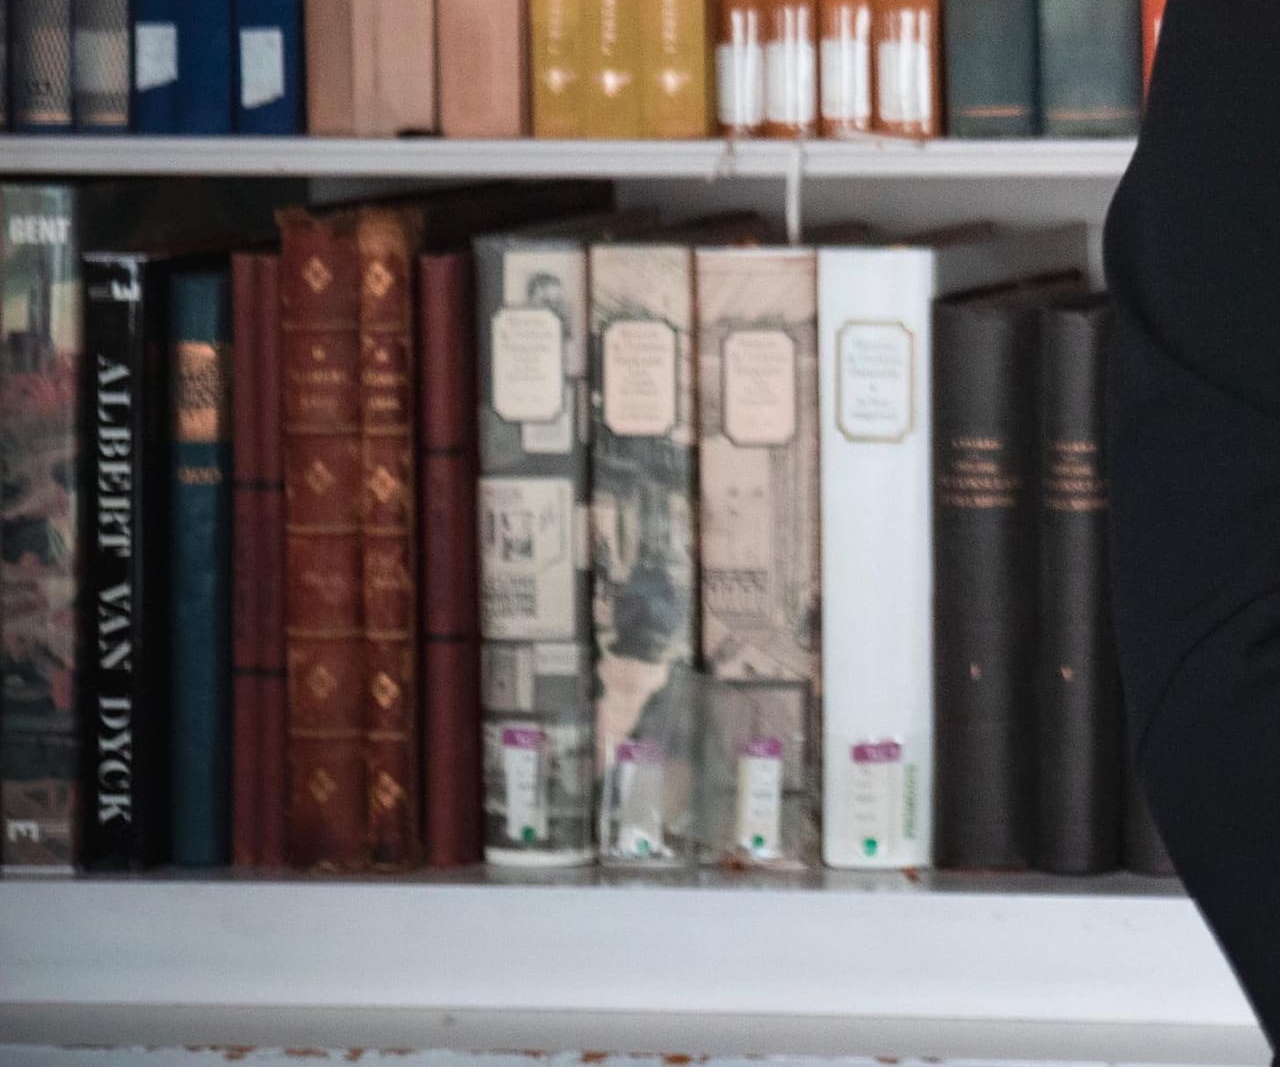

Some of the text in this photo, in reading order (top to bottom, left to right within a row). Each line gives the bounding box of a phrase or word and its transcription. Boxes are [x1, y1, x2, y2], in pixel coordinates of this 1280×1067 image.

[9, 215, 71, 245] GENT
[98, 353, 133, 825] ALBERT VAN DYCK
